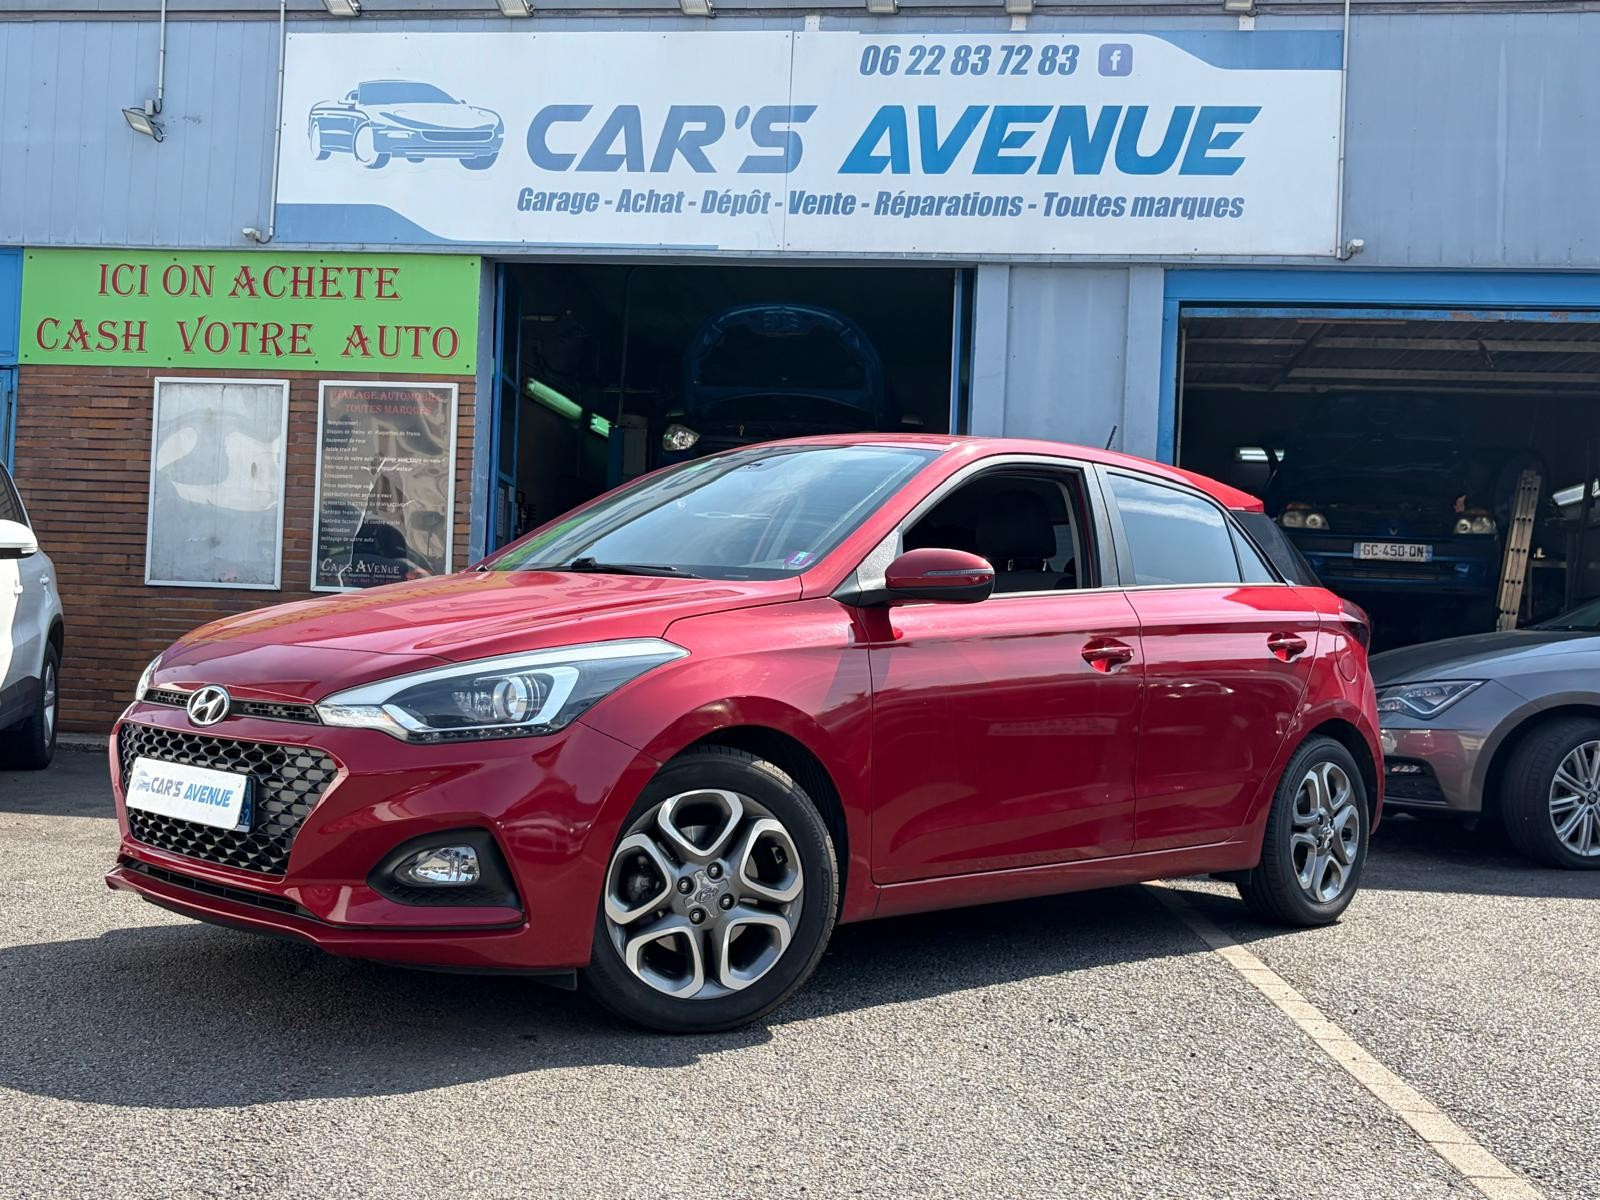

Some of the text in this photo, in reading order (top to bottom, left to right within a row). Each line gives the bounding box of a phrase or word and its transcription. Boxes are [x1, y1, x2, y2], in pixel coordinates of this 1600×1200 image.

[858, 44, 1080, 76] 06 22 83 72 83
[526, 104, 1263, 177] CAR'S AVENUE
[517, 187, 1245, 221] Garage Achat Dépôt Vente Réparations Toutes marques
[98, 263, 401, 300] ICI ON ACHETE
[36, 315, 460, 360] CASH VOTRE AUTO
[345, 403, 382, 414] TOUTES
[1362, 544, 1424, 558] GC-450-QN
[150, 776, 234, 808] CAR'S AVENUE
